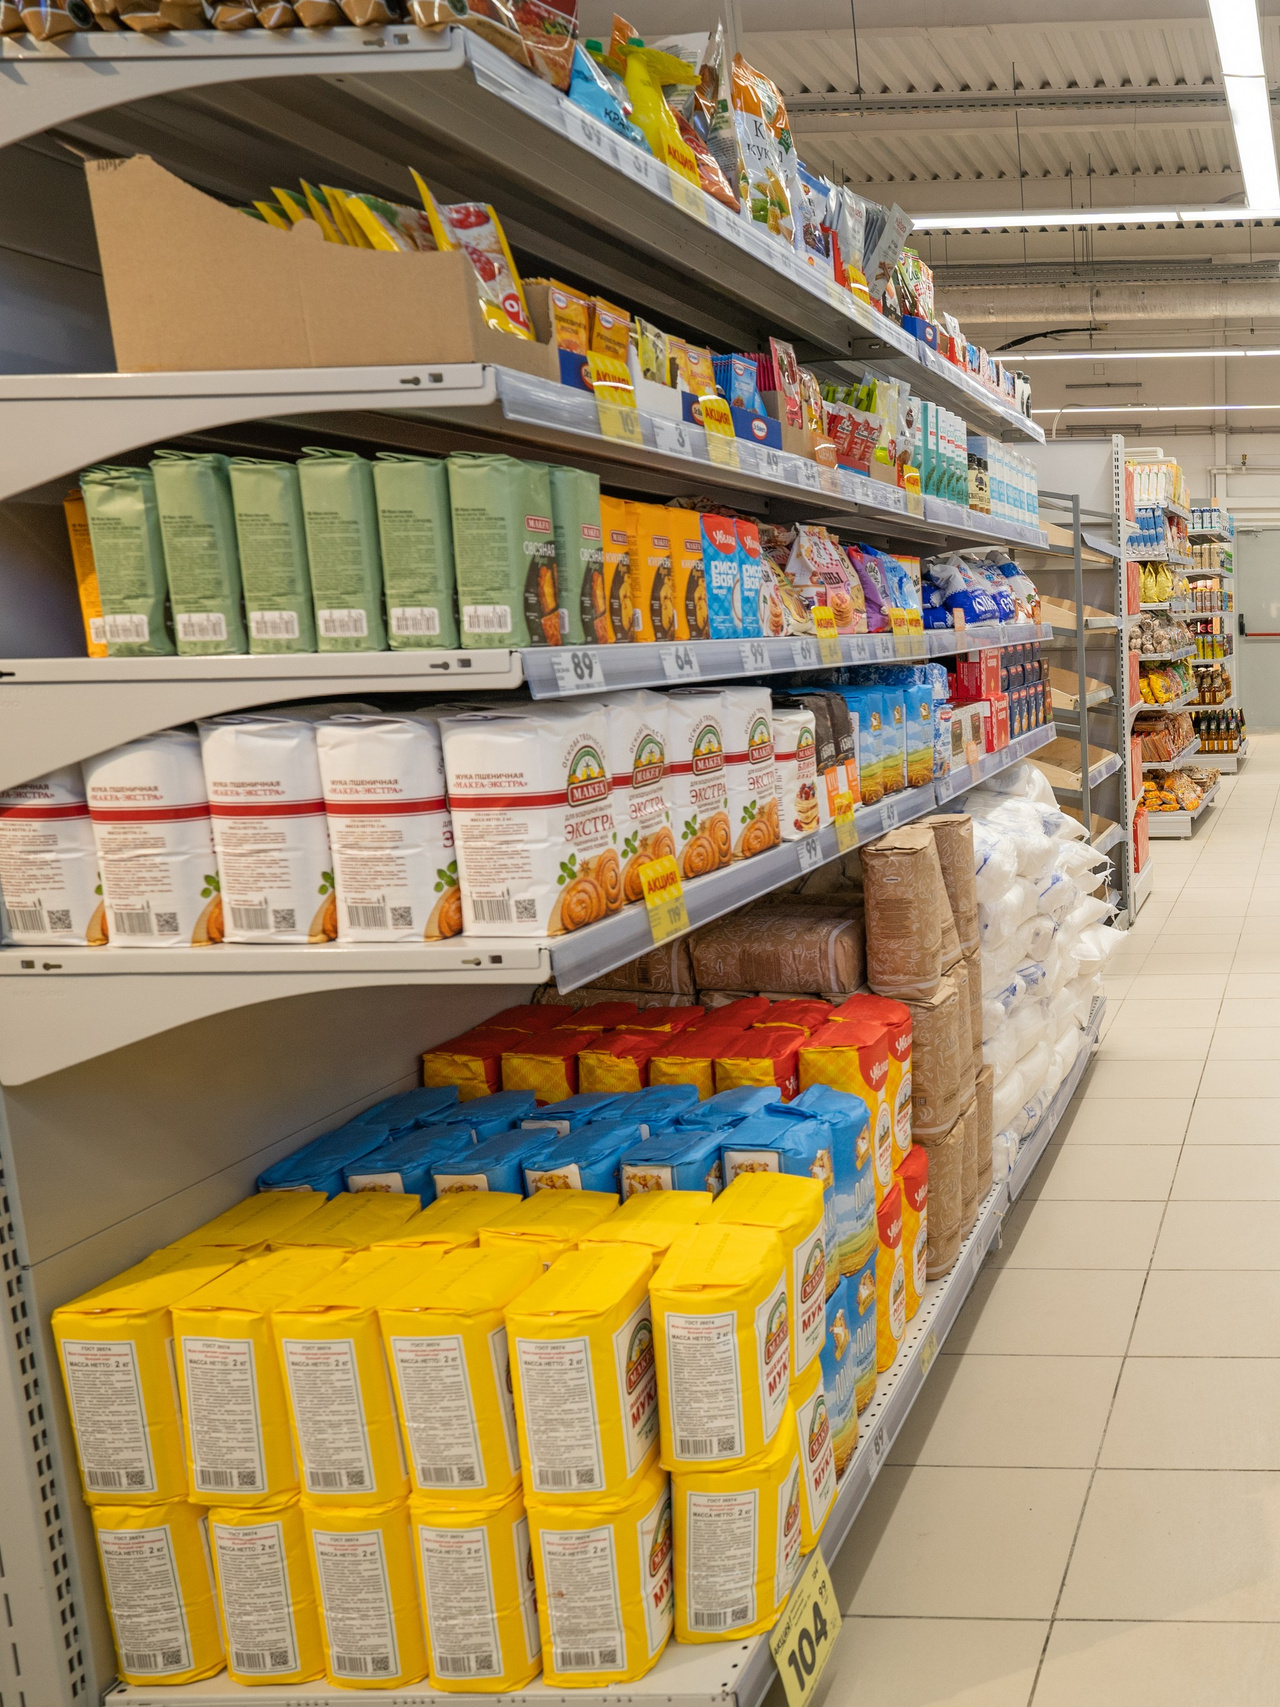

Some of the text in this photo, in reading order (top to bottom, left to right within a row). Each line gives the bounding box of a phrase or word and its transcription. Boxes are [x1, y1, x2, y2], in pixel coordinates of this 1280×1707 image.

[667, 144, 696, 175] АКЦИЯ!
[705, 406, 731, 426] АКЦИЯ!
[571, 652, 594, 680] 89
[675, 647, 693, 671] 64
[696, 755, 722, 772] MAKFA
[572, 781, 605, 801] MAKFA
[690, 783, 728, 805] ЭКСТРА
[629, 795, 668, 820] ЭКСТРА
[564, 813, 615, 842] ЭКСТРА
[646, 870, 679, 895] АКЦИЯ!
[818, 1579, 826, 1597] 99
[787, 1601, 828, 1692] 104
